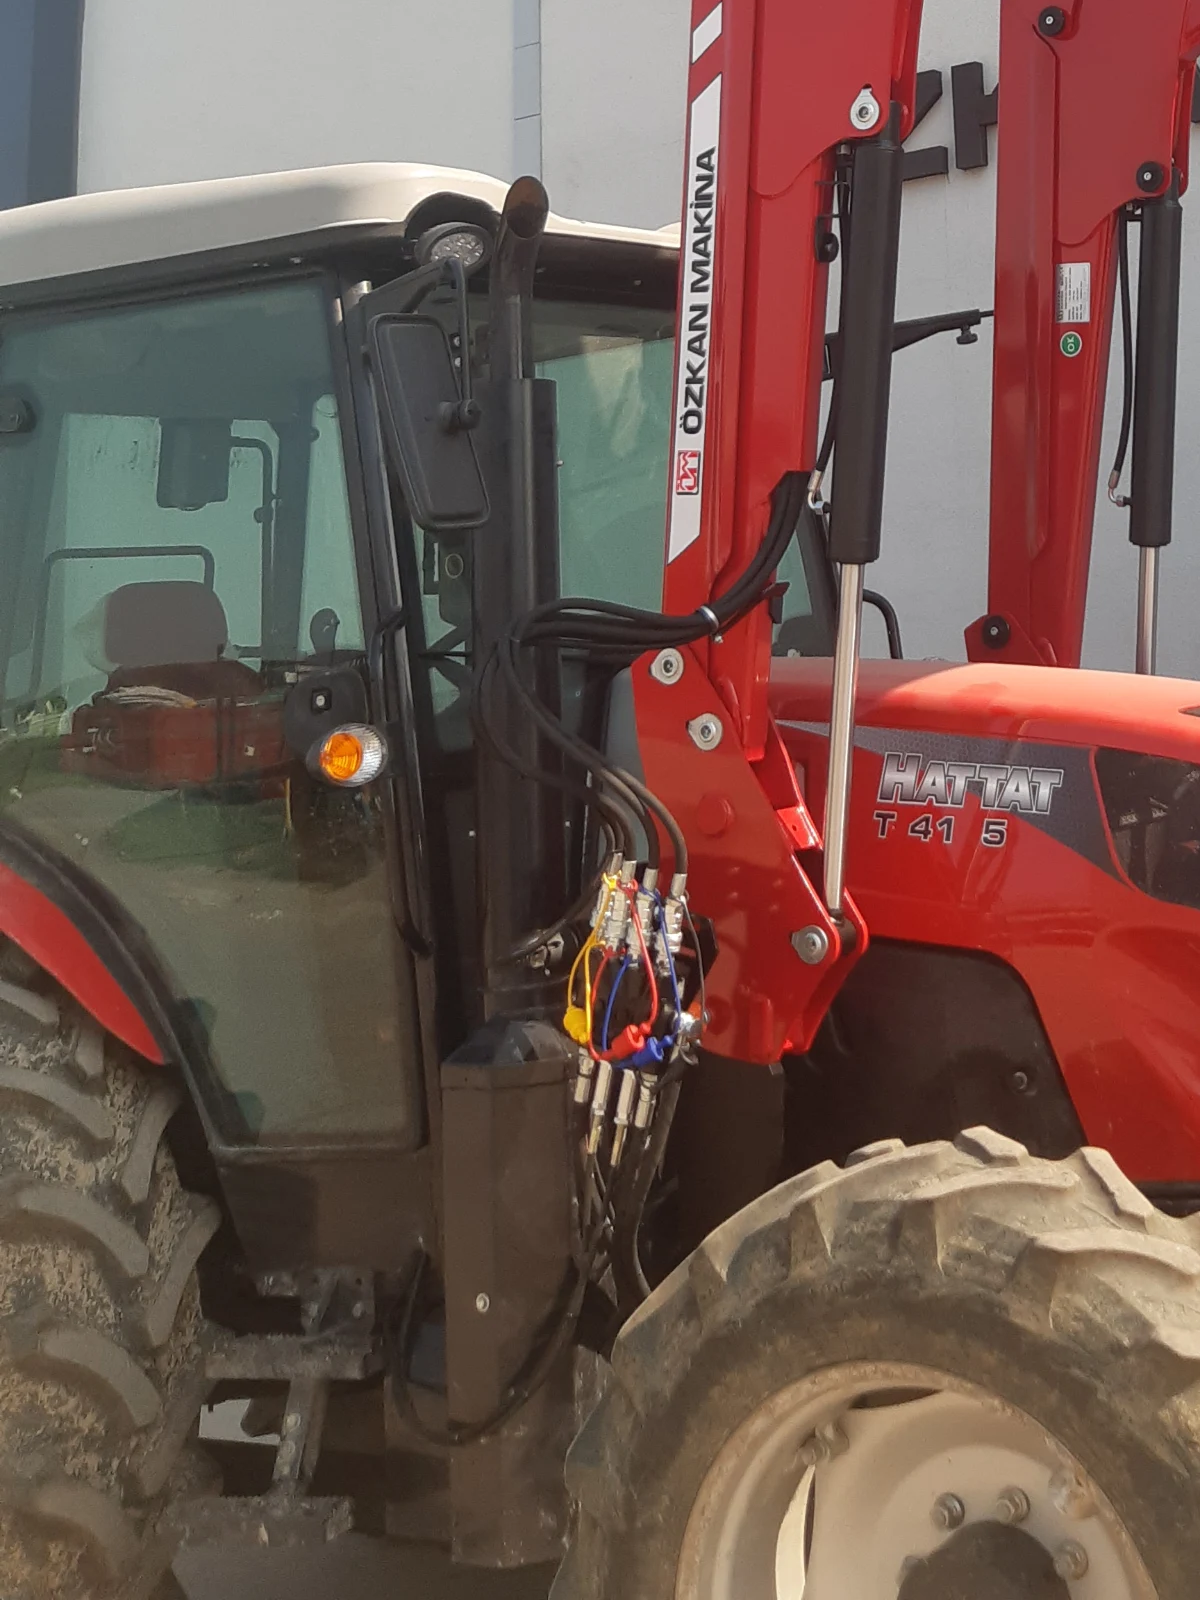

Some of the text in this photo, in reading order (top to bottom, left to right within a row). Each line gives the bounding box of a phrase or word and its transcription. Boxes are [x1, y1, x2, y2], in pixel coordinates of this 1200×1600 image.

[690, 146, 716, 293] MAKİNA
[679, 303, 709, 435] ÖZKAN
[1066, 335, 1076, 353] OK
[877, 752, 1064, 815] HATTAT
